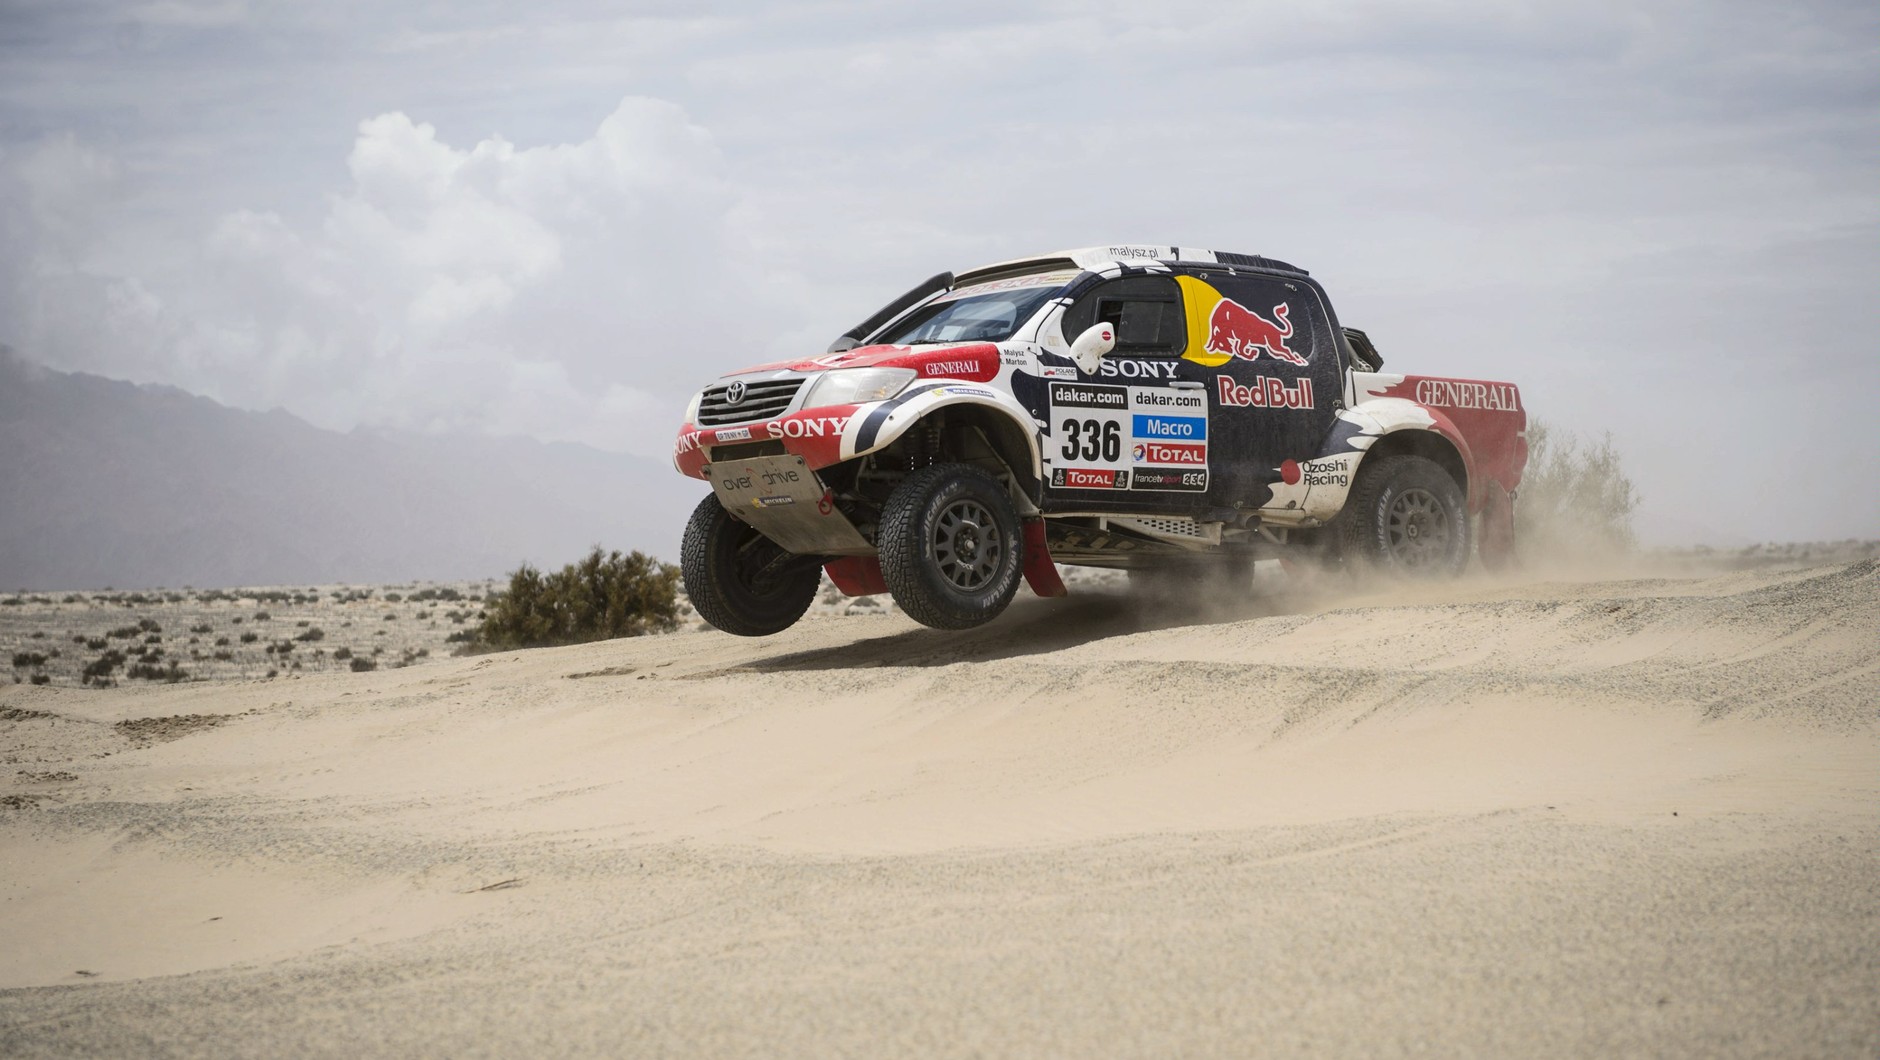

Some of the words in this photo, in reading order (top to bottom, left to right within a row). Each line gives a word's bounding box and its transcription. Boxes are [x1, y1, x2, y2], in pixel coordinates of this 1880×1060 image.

[1109, 246, 1159, 260] malysz.pl
[925, 361, 980, 376] GENERALI
[1005, 358, 1028, 366] Marton
[1100, 360, 1179, 379] SONY
[1055, 387, 1125, 404] dakar.com
[1136, 392, 1201, 408] dakar.com
[1216, 375, 1266, 408] Red
[1266, 376, 1315, 410] Bull
[1415, 380, 1518, 412] GENERALI
[766, 416, 849, 439] SONY
[1147, 419, 1193, 436] Macro
[1062, 418, 1121, 463] 336
[1150, 446, 1203, 462] TOTAL
[1302, 459, 1348, 473] Ozoshi
[723, 476, 753, 490] over
[762, 468, 800, 485] drive
[1069, 471, 1112, 485] TOTAL
[1303, 473, 1348, 487] Racing
[982, 550, 1018, 608] MICHELIN
